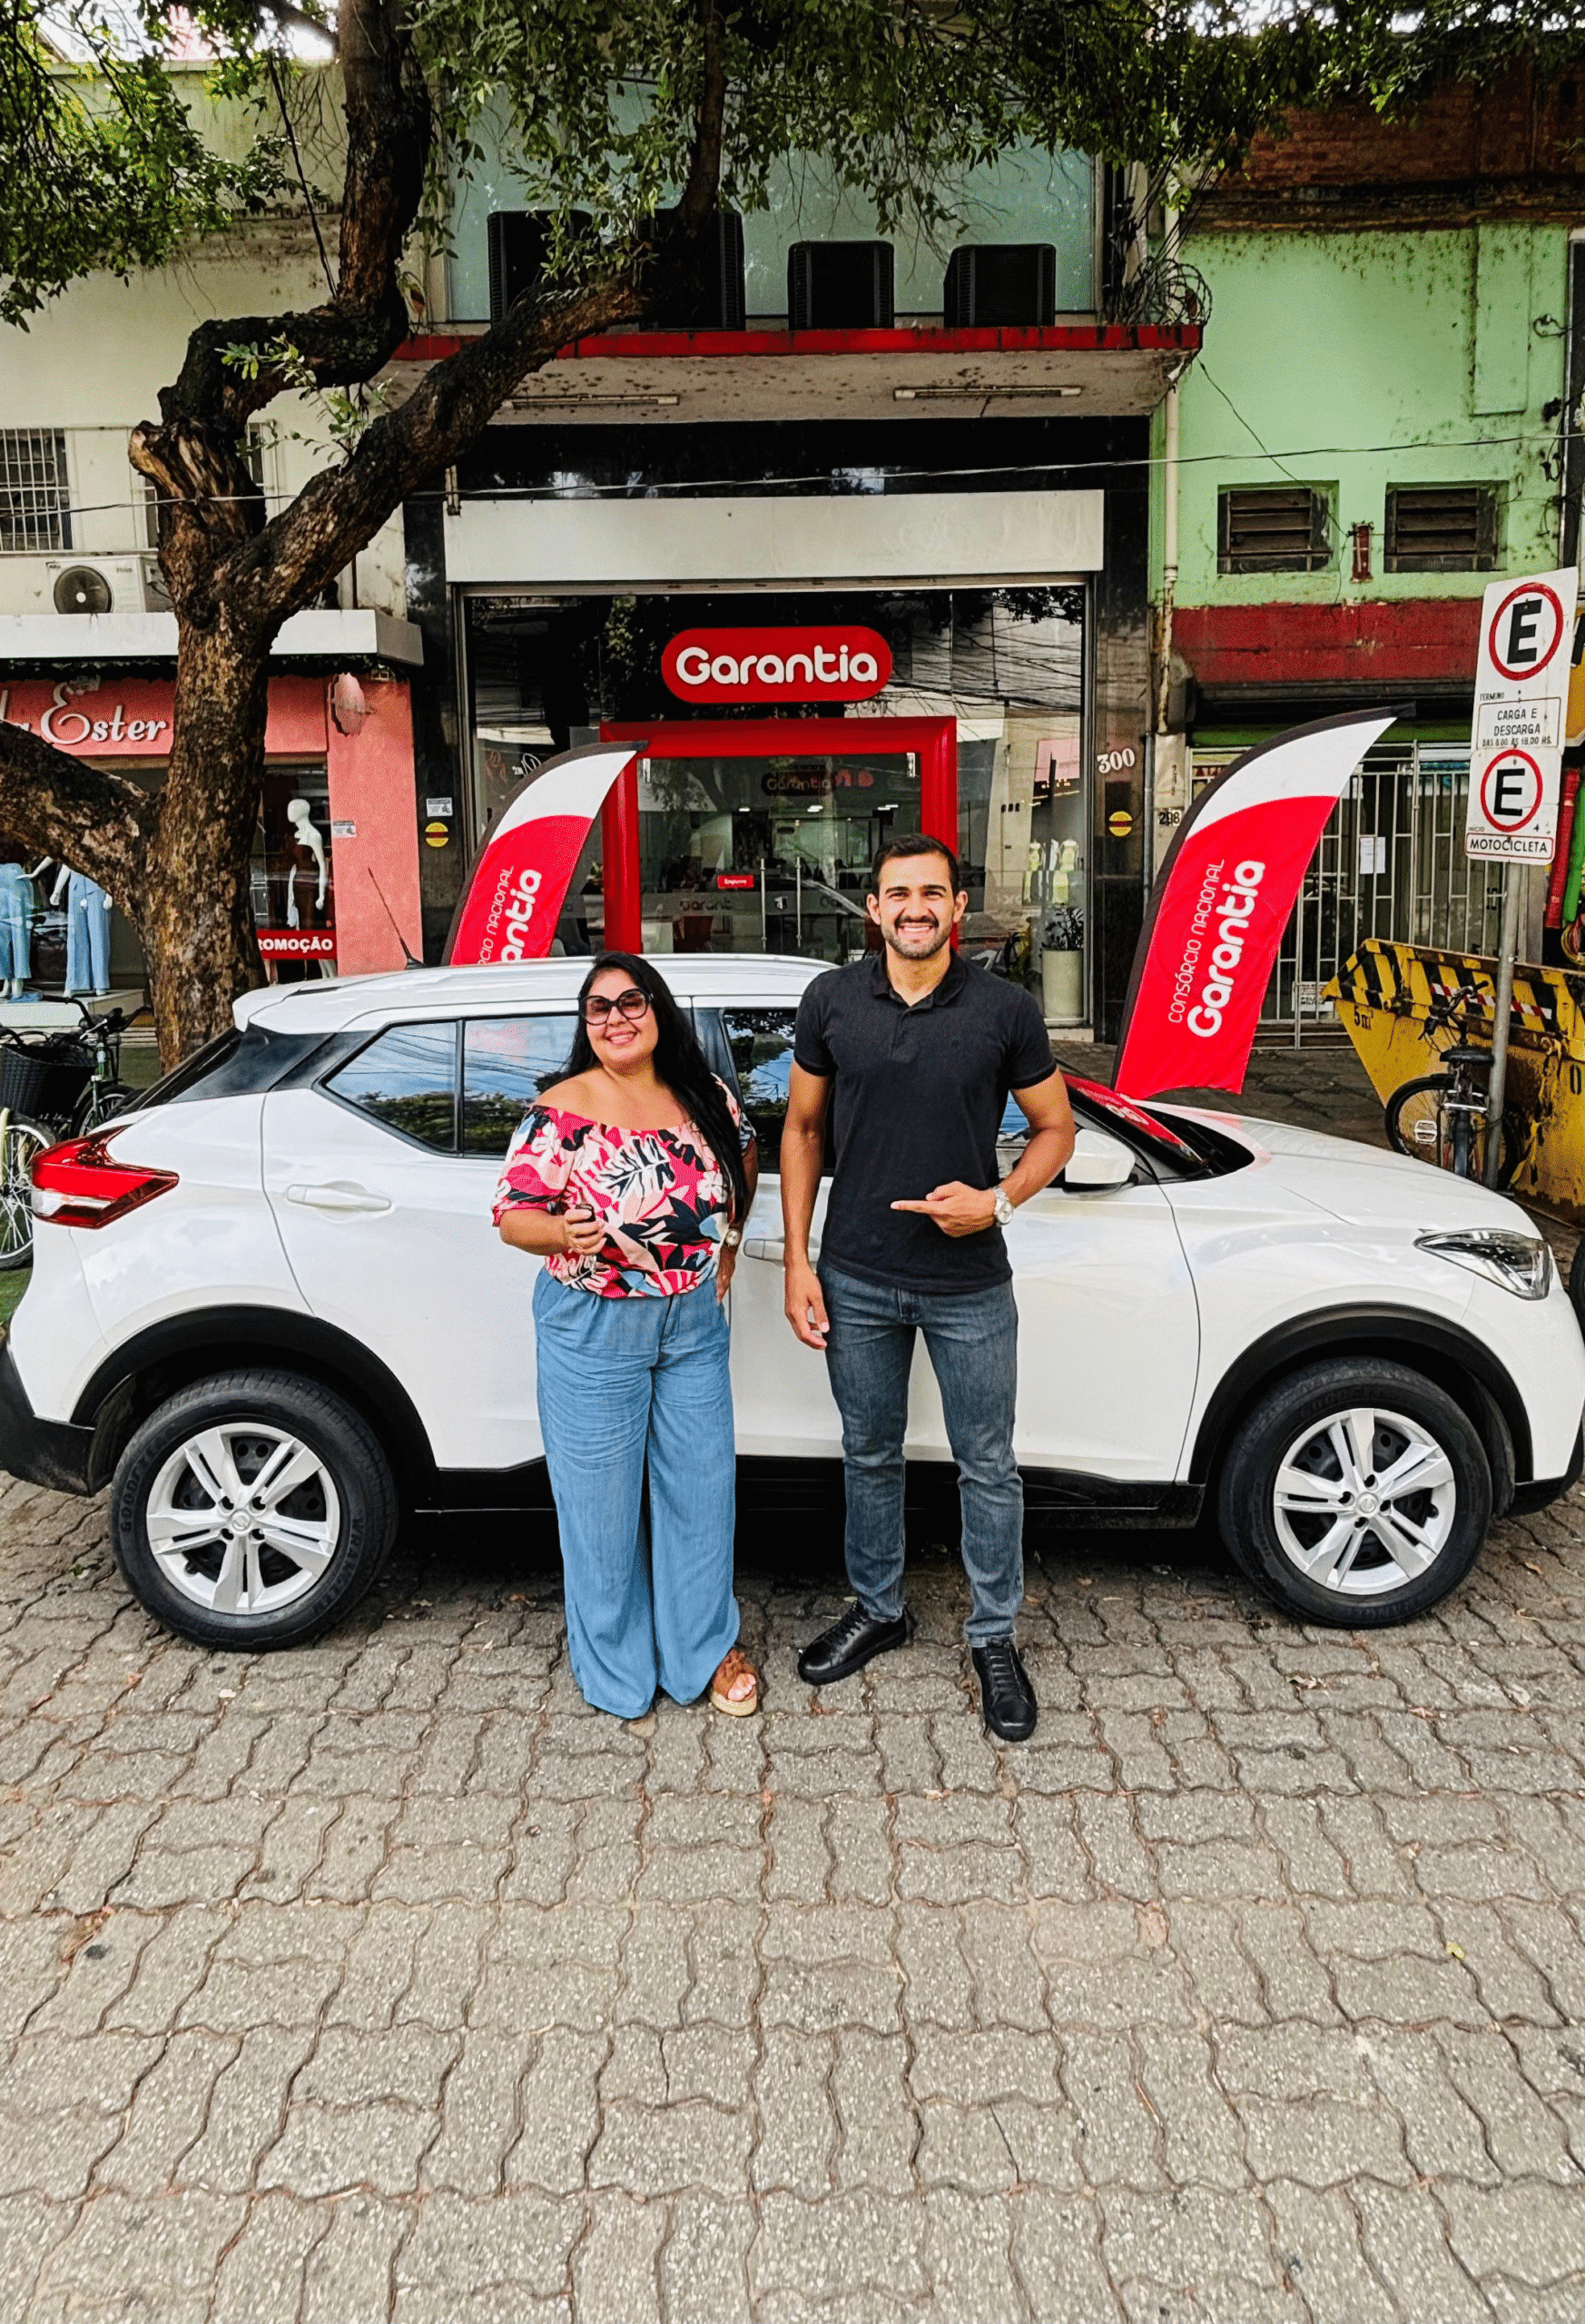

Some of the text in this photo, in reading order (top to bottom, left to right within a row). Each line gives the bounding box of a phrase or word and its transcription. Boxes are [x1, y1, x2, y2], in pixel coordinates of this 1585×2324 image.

[1507, 599, 1542, 665] E
[676, 645, 878, 684] Garantia
[40, 682, 167, 744] Ester
[1493, 724, 1541, 736] DESCARGA
[1497, 708, 1538, 720] CARGA E
[1096, 748, 1136, 773] 300
[1493, 768, 1525, 816] E
[1157, 811, 1180, 826] 298
[1470, 839, 1548, 853] MOTOCICLETA
[486, 865, 515, 936] NACIONAL
[501, 869, 543, 962] antia
[258, 936, 333, 953] ROMOÇÃO
[1168, 859, 1225, 1024] CONSÓRCIO NACIONAL
[1186, 860, 1265, 1038] Garantia
